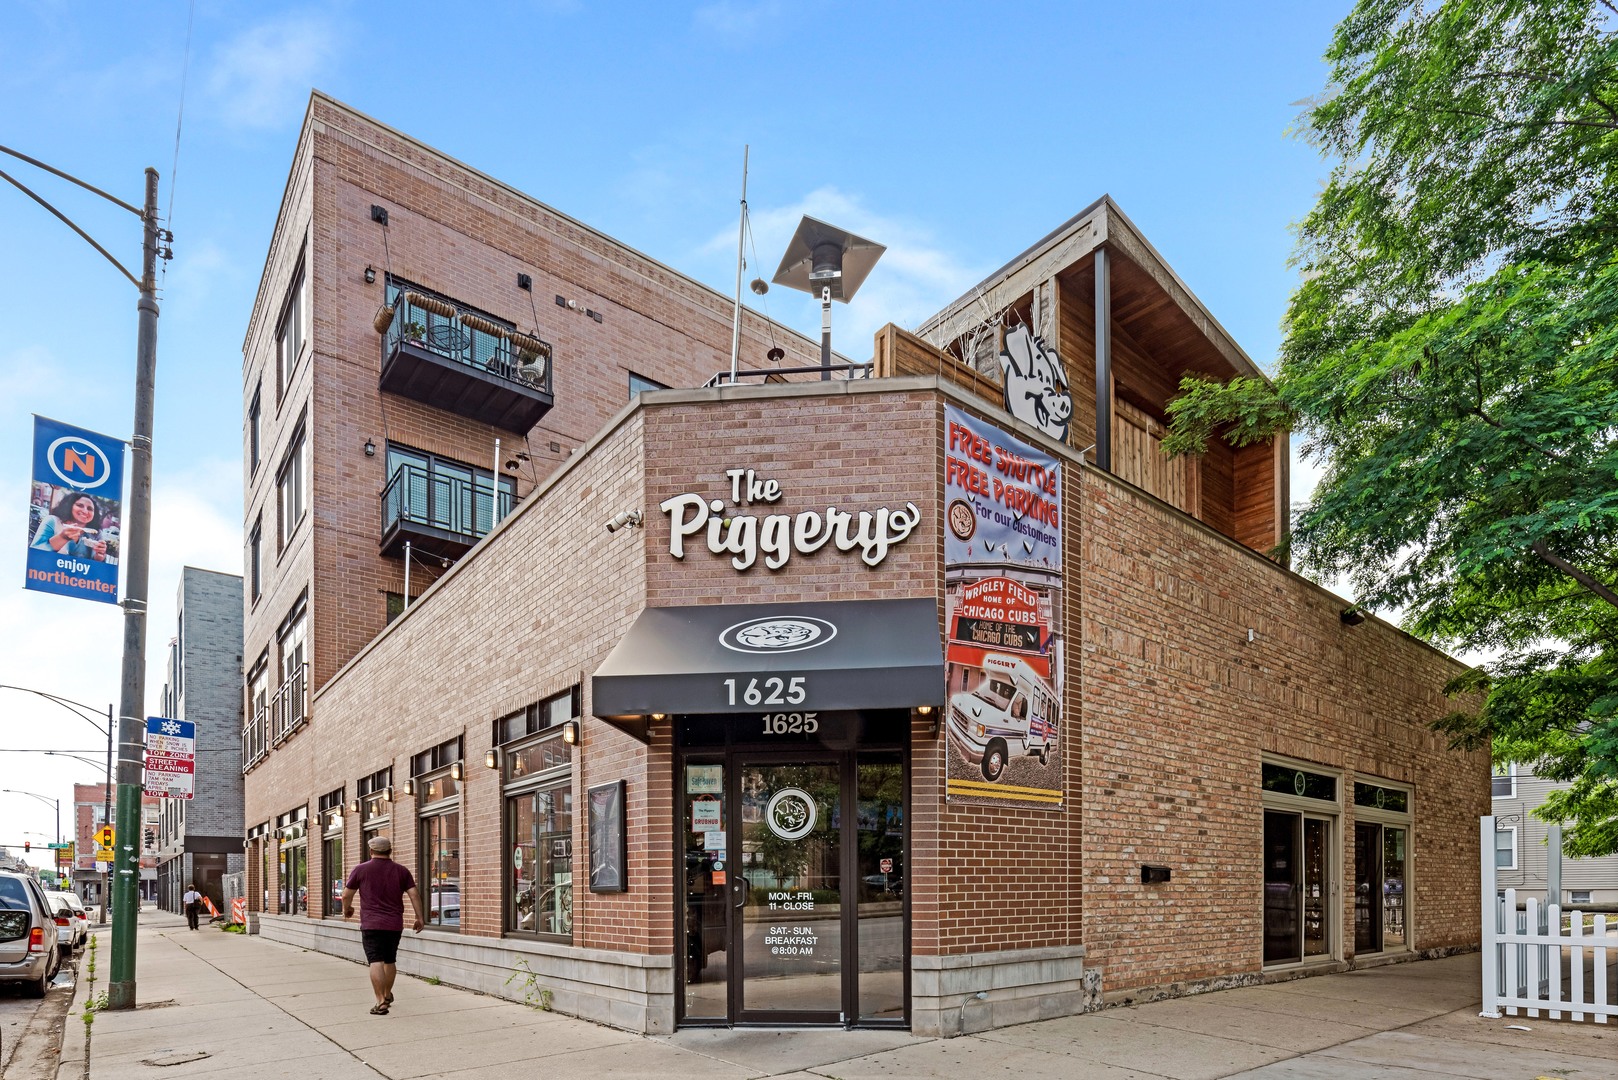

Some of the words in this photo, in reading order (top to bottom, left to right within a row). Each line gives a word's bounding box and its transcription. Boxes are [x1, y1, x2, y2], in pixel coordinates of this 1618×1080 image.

[949, 420, 992, 466] FREE
[994, 445, 1057, 497] SHUTTLE
[726, 468, 782, 505] The
[946, 454, 990, 498] FREE
[993, 476, 1059, 530] PARKING
[659, 492, 922, 571] Piggery
[975, 501, 992, 520] For
[994, 511, 1011, 528] our
[1012, 519, 1057, 548] customers
[56, 558, 91, 575] enjoy
[28, 569, 116, 594] northcenter
[965, 581, 1005, 600] WRIGLEY
[1008, 583, 1036, 606] FIELD
[983, 595, 1002, 604] HOME
[1006, 597, 1016, 605] OF
[963, 605, 1004, 620] CHICAGO
[1008, 610, 1036, 624] CUBS
[979, 621, 993, 631] HOME
[995, 622, 1003, 631] OF
[1005, 624, 1016, 634] THE
[972, 628, 1000, 644] CHICAGO
[1003, 633, 1023, 647] CUBS
[987, 659, 1016, 669] PIGGERY
[723, 677, 806, 706] 1625
[762, 713, 819, 735] 1625
[148, 764, 189, 772] CLEANING
[149, 758, 177, 766] STREET
[797, 892, 814, 900] FRI.
[769, 902, 777, 910] 11
[783, 902, 814, 910] CLOSE
[793, 927, 814, 935] SUN.
[765, 936, 818, 945] BREAKFAST
[799, 946, 813, 955] AM
